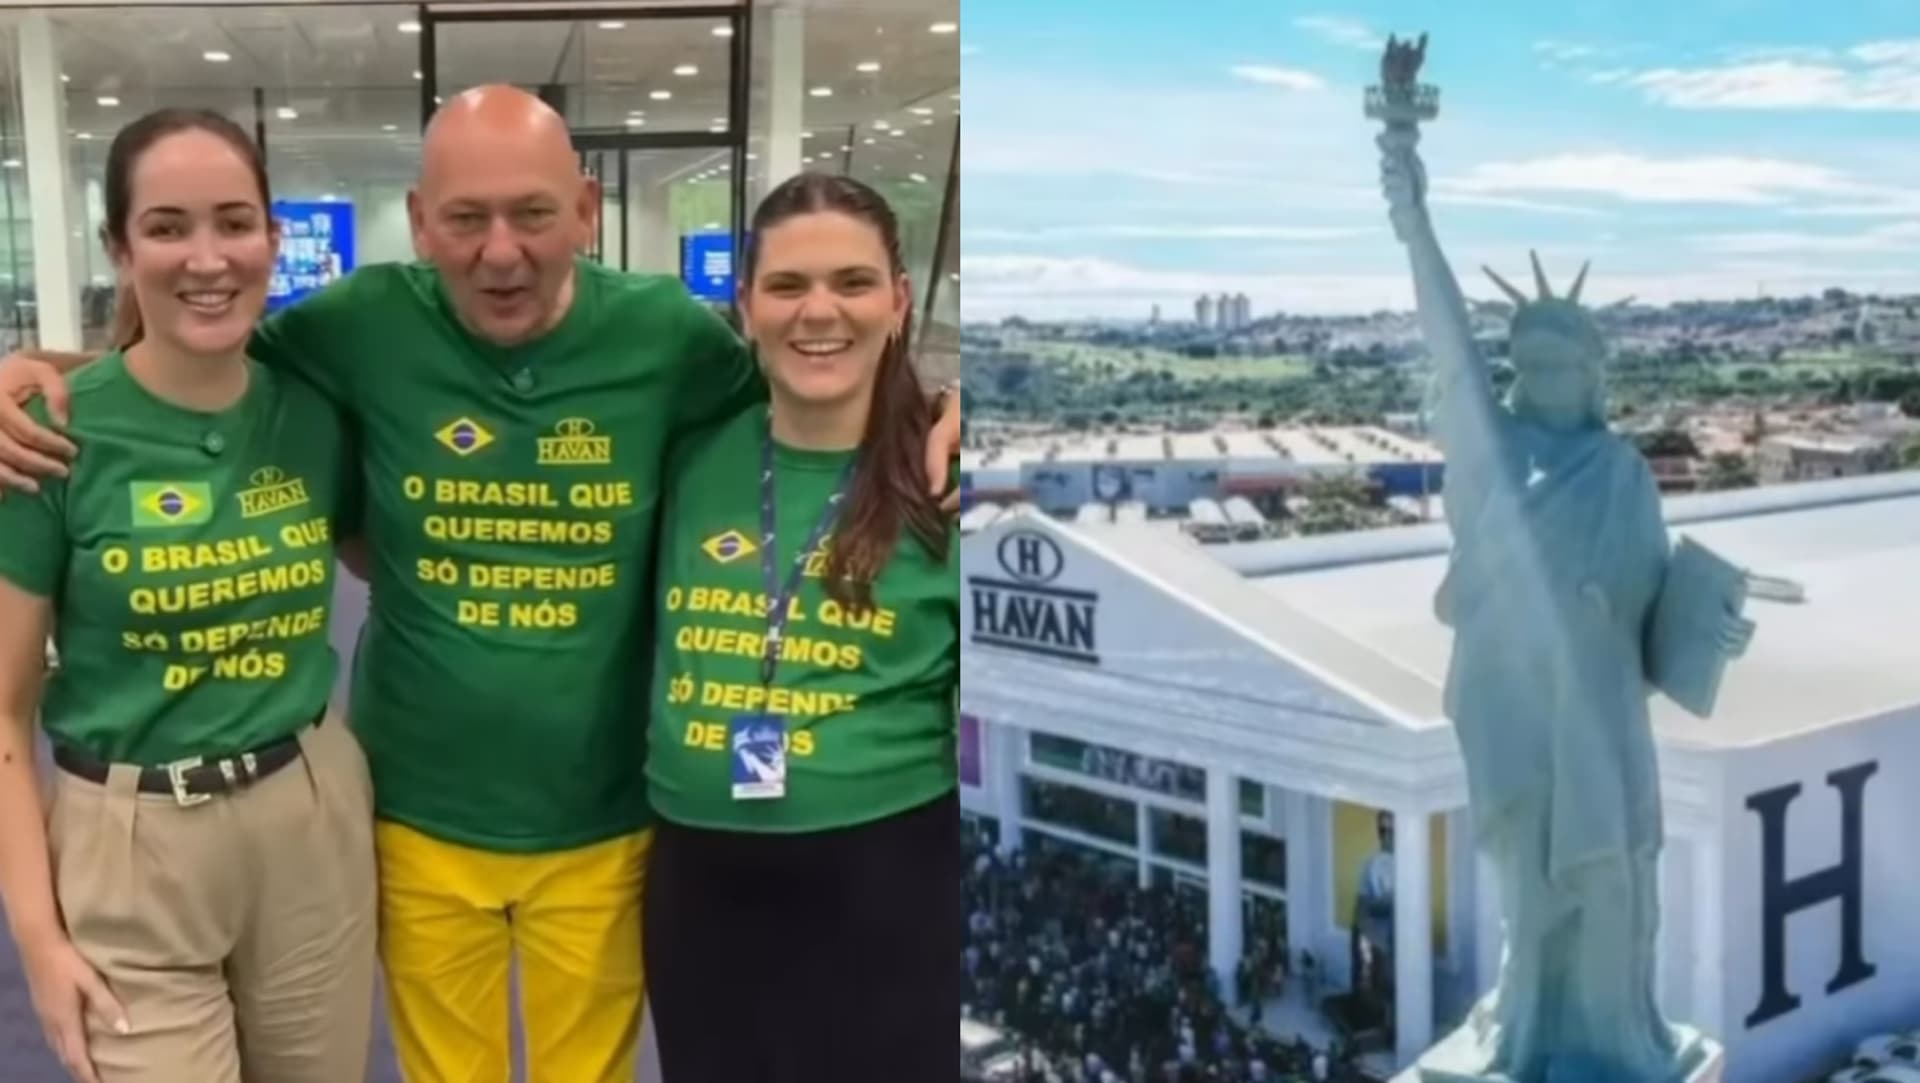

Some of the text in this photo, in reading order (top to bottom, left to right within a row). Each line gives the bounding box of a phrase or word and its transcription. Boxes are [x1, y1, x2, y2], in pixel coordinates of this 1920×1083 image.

[538, 438, 611, 461] HAVAN
[241, 482, 306, 514] HAVAN
[403, 475, 632, 508] O BRASIL QUE
[102, 518, 328, 573] O BRASIL QUE
[424, 515, 612, 544] QUEREMOS
[1017, 537, 1041, 576] H
[129, 559, 325, 614] QUEREMOS
[416, 557, 615, 590] SÓ DEPENDE
[457, 597, 577, 628] DE NÓS
[666, 587, 896, 637] O BRASL QUE
[972, 589, 1094, 650] HAVAN
[181, 607, 323, 652] DEPENDE
[214, 647, 286, 678] NÓS
[684, 722, 727, 750] DE
[1745, 760, 1879, 1029] H
